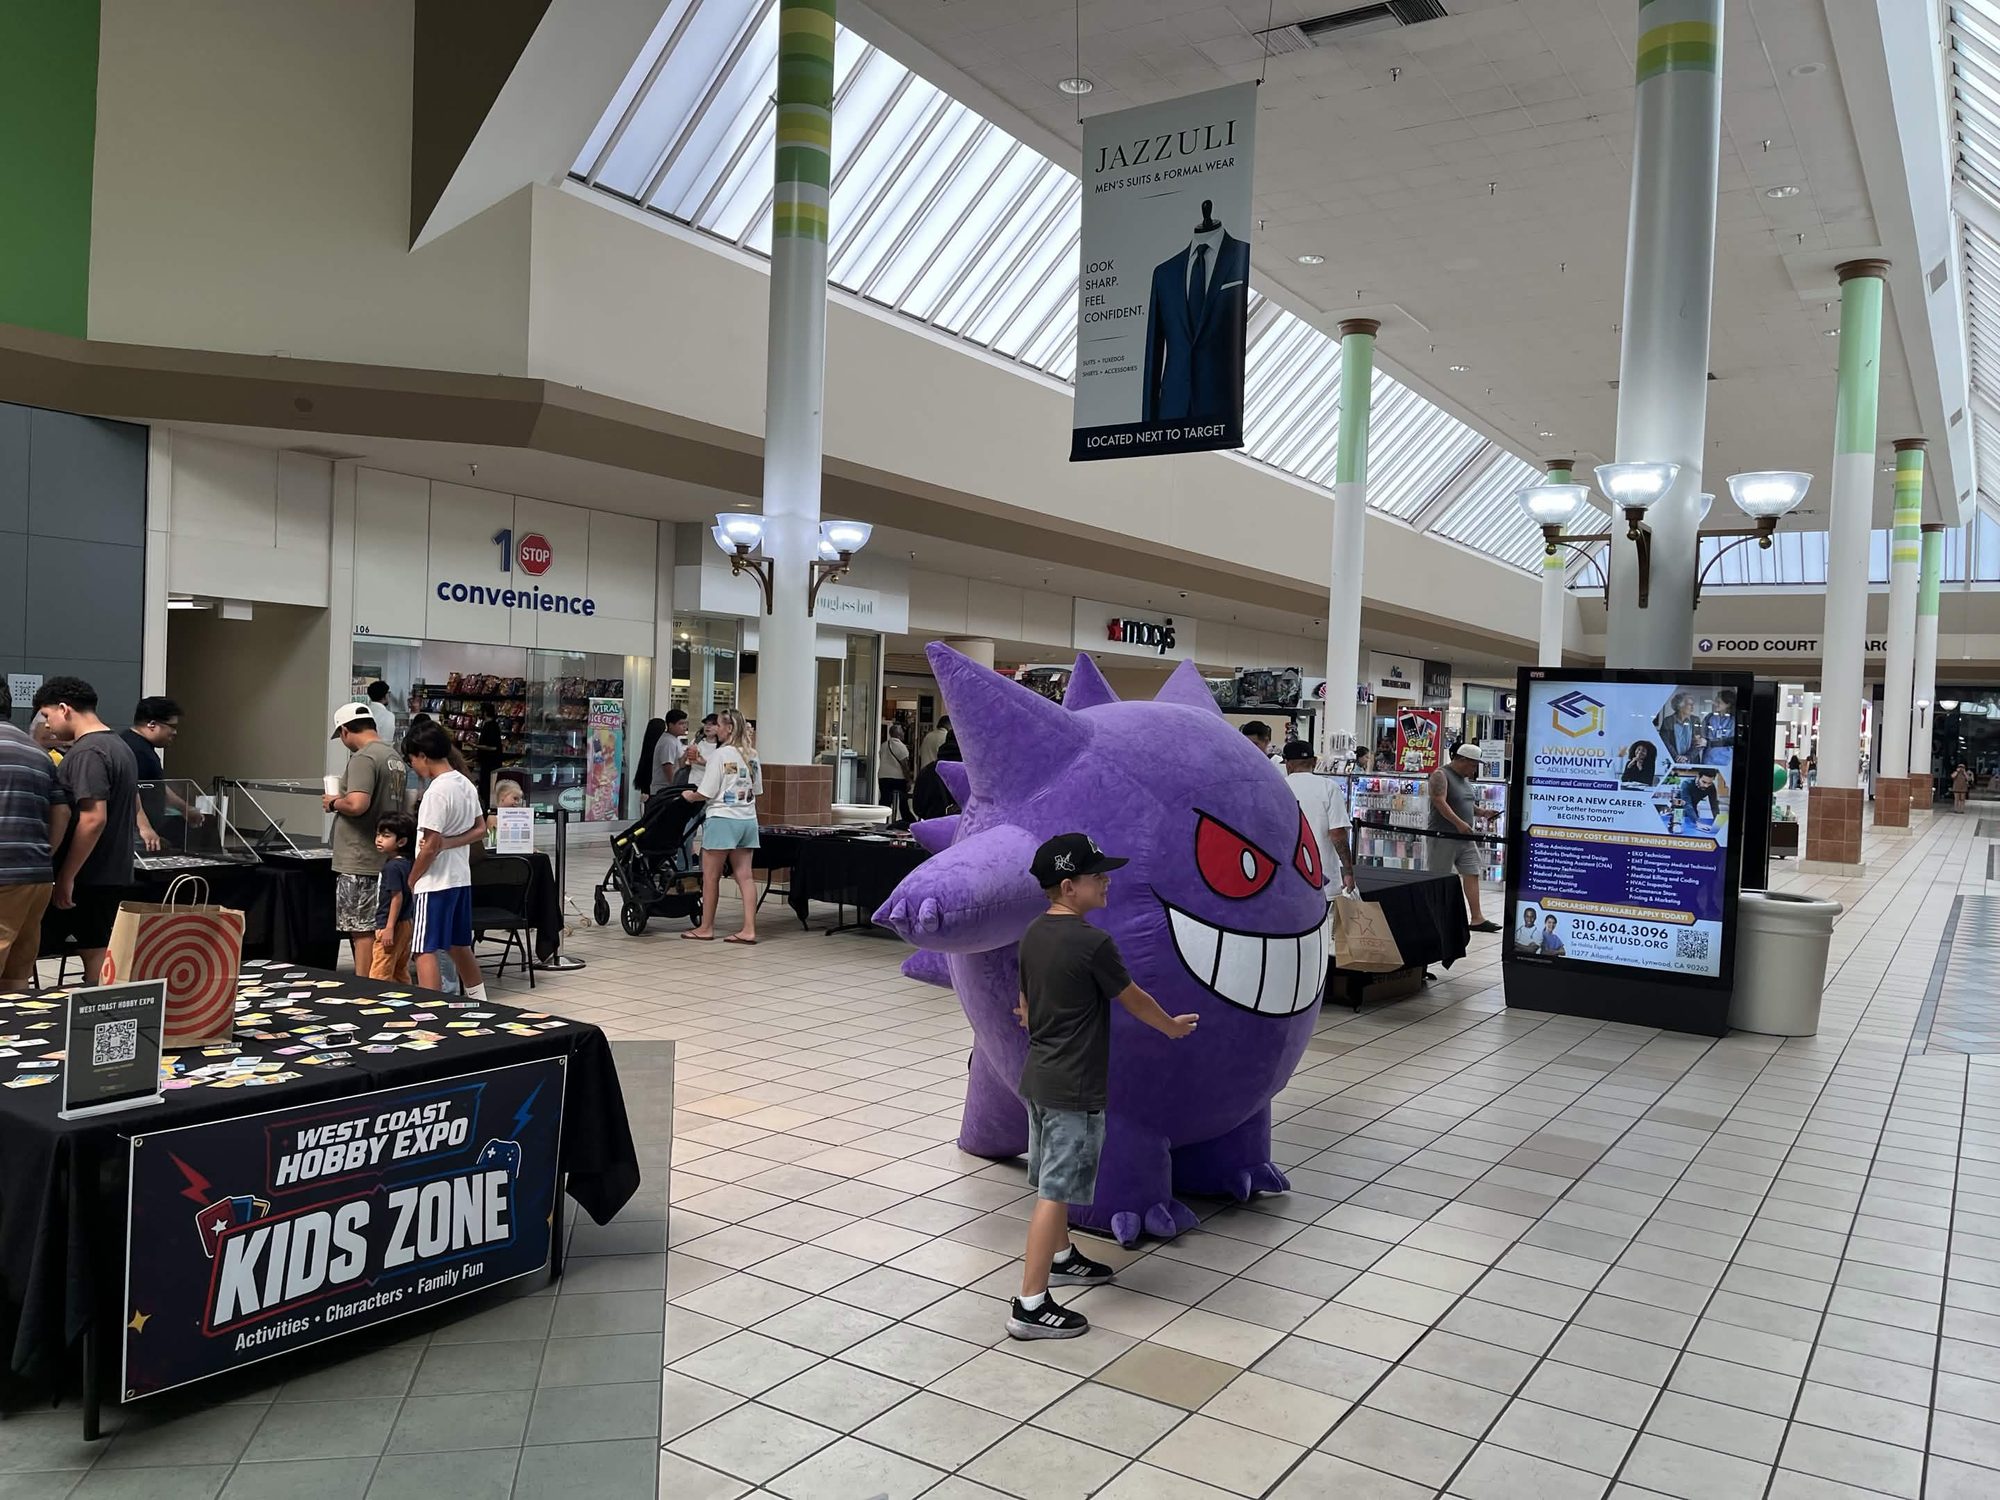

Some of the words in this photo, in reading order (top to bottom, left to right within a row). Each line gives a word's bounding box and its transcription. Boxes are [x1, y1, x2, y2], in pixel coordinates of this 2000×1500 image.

[1096, 120, 1236, 173] JAZZULI
[1096, 180, 1123, 194] MEN'S
[1127, 174, 1152, 188] SUITS
[1154, 172, 1161, 182] &
[1164, 165, 1202, 180] FORMAL
[1206, 157, 1235, 172] WEAR
[1086, 260, 1114, 274] LOOK
[1086, 276, 1118, 290] SHARP.
[1085, 295, 1105, 307] FEEL
[1085, 305, 1144, 323] CONFIDENT.
[1088, 434, 1133, 448] LOCATED
[1136, 430, 1163, 443] NEXT
[1166, 429, 1180, 440] TO
[1184, 424, 1225, 438] TARGET
[522, 546, 550, 563] STOP
[437, 582, 596, 616] convenience
[355, 625, 370, 633] 106
[1717, 640, 1759, 651] FOOD
[1763, 640, 1818, 651] COURT
[593, 704, 620, 713] VIRAL
[1408, 739, 1430, 747] Cell
[1542, 746, 1605, 757] LYNWOOD
[1535, 756, 1613, 768] COMMUNITY
[1530, 793, 1555, 801] TRAIN
[1558, 795, 1574, 803] FOR
[1585, 797, 1607, 805] NEW
[1566, 804, 1586, 812] better
[1588, 807, 1625, 815] tomorrow
[1557, 813, 1585, 821] BEGINS
[1587, 815, 1614, 823] TODAY!
[1603, 834, 1629, 842] CAREER
[1631, 836, 1667, 846] TRAINING
[1669, 839, 1712, 849] PROGRAMS
[1547, 900, 1599, 912] SCHOLARSHIPS
[1600, 906, 1637, 916] AVAILABLE
[1637, 910, 1660, 918] APPLY
[1572, 919, 1668, 939] 310.604.3096
[1572, 932, 1668, 950] LCAS.MYLUSD.ORG
[1687, 964, 1708, 972] 90262
[79, 1004, 95, 1014] WEST
[97, 1002, 117, 1012] COAST
[118, 1000, 138, 1008] HOBBY
[140, 997, 155, 1006] EXPO
[297, 1117, 369, 1149] WEST
[374, 1100, 452, 1134] COAST
[275, 1134, 384, 1187] HOBBY
[393, 1117, 470, 1158] EXPO
[213, 1200, 370, 1326] KIDS
[384, 1169, 509, 1269] ZONE
[235, 1316, 309, 1351] Activities
[326, 1287, 403, 1323] Characters
[418, 1269, 459, 1295] Family
[463, 1260, 483, 1281] Fun
